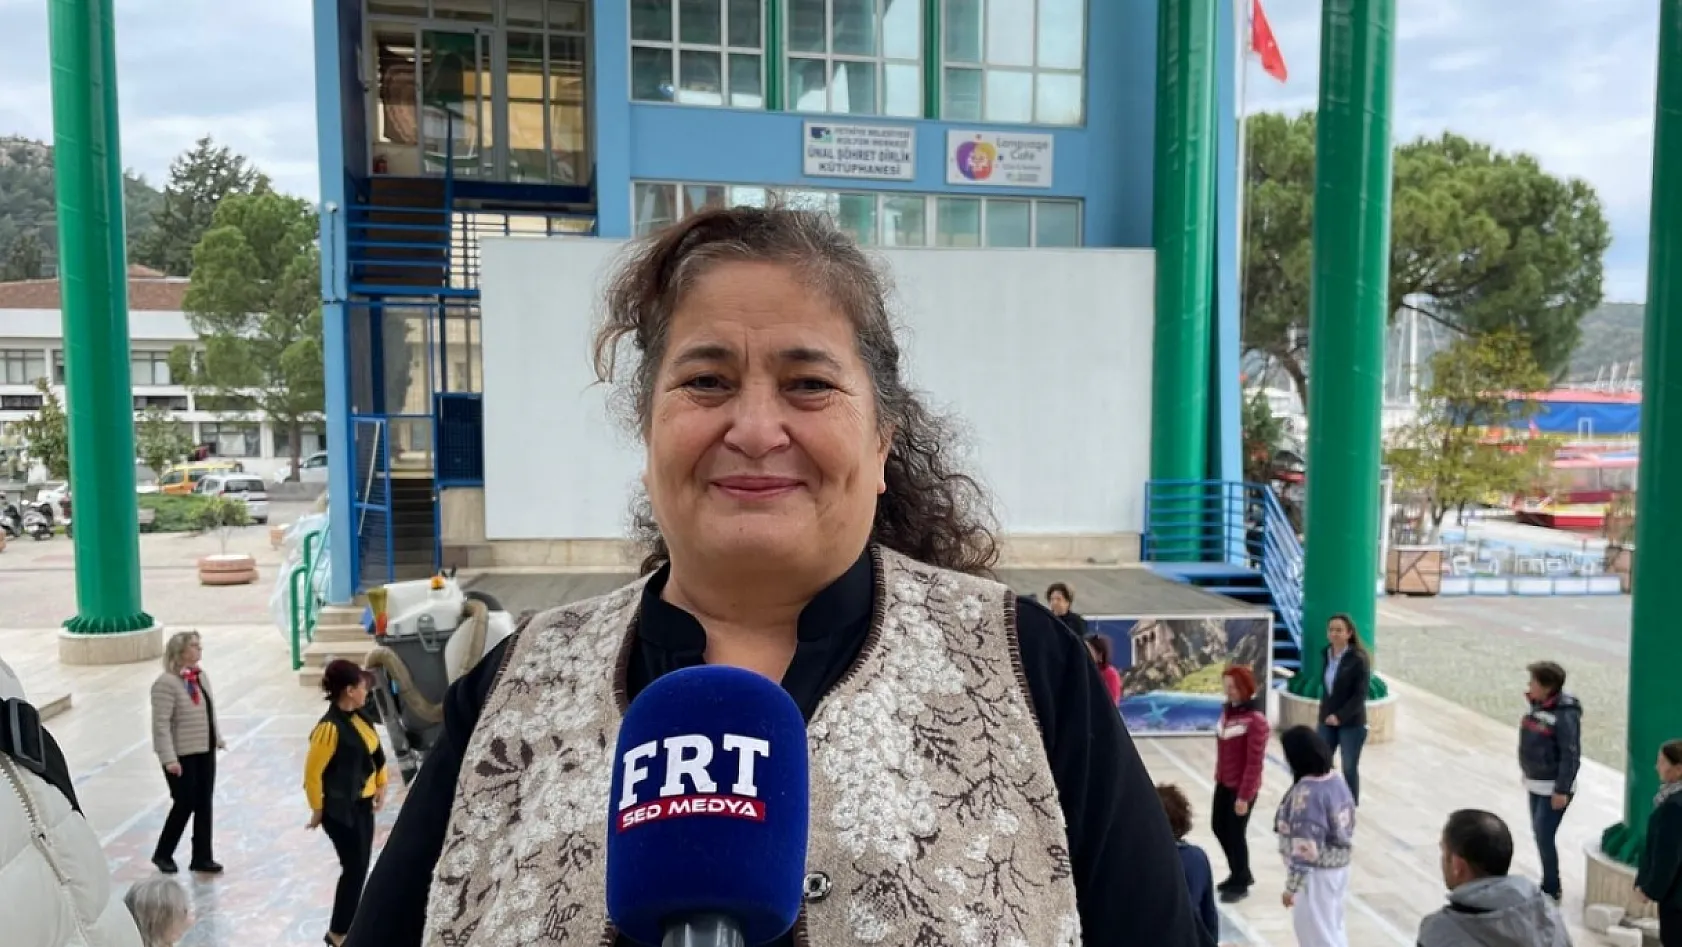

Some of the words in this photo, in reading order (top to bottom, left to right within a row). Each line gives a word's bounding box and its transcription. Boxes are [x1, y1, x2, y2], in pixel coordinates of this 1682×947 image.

[996, 137, 1048, 152] Language
[619, 734, 769, 811] FRT
[622, 804, 661, 829] SED
[668, 798, 757, 817] MEDYA
